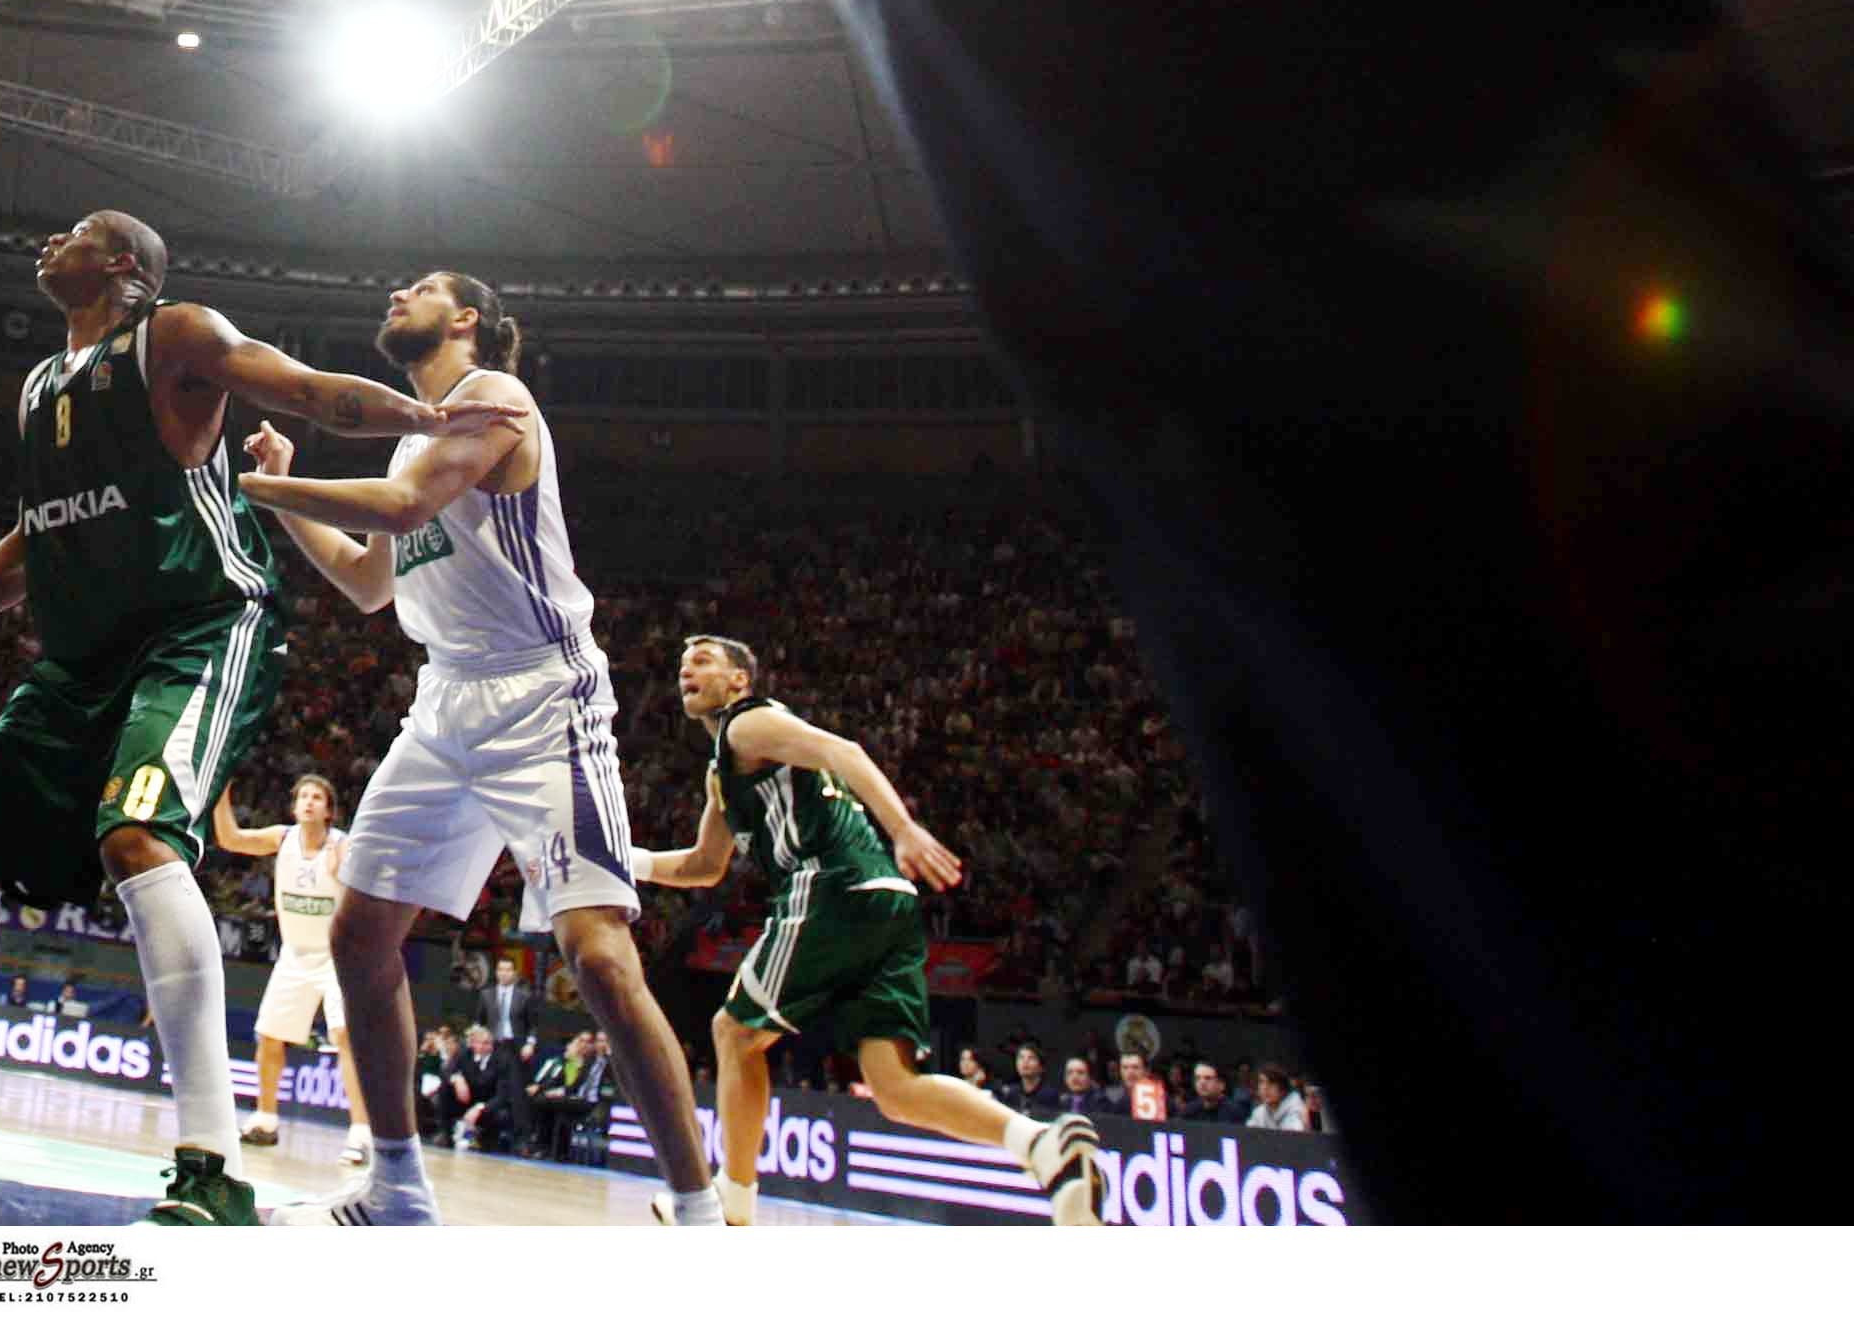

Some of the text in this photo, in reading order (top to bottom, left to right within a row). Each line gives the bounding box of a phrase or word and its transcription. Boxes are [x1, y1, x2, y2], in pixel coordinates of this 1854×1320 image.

[56, 393, 72, 448] 8
[23, 483, 130, 537] NOKIA
[123, 764, 166, 821] 8
[1134, 1084, 1158, 1119] 5
[695, 1096, 837, 1183] adas
